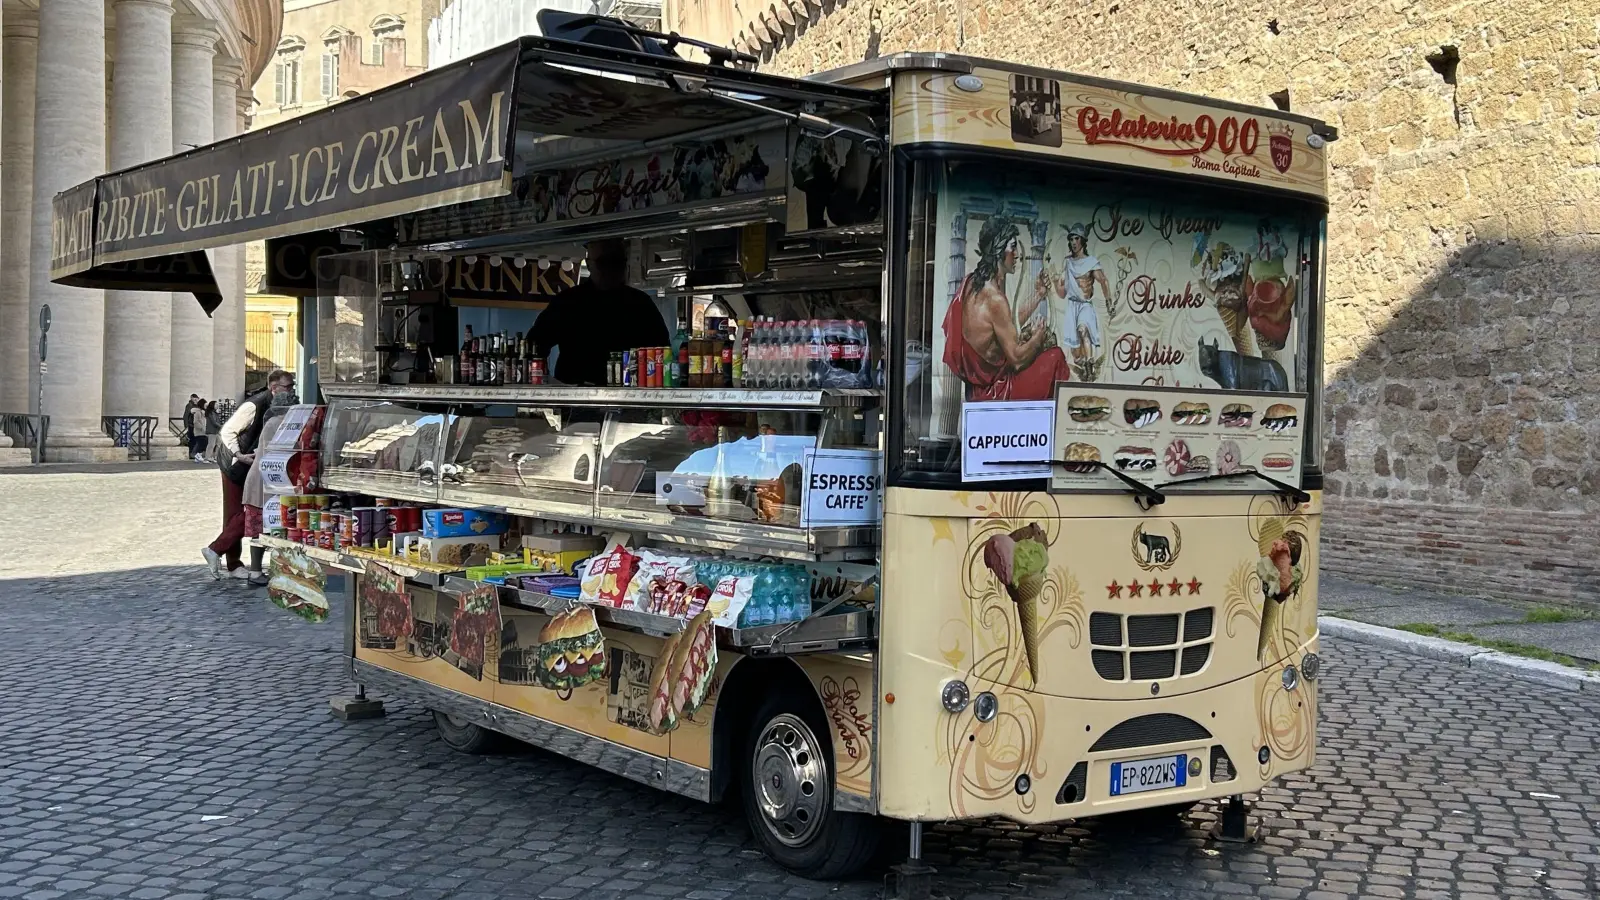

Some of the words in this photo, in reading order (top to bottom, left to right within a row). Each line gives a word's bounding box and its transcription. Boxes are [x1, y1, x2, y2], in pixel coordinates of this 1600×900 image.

[347, 91, 505, 194] CREAM
[1275, 152, 1289, 168] 30
[1191, 156, 1220, 173] Roma
[1222, 160, 1261, 178] Capitale
[1092, 203, 1145, 243] Ice
[1148, 205, 1223, 246] Cream
[1127, 274, 1206, 314] Drinks
[1113, 332, 1185, 372] Bibite
[967, 433, 1048, 450] CAPPUCCINO
